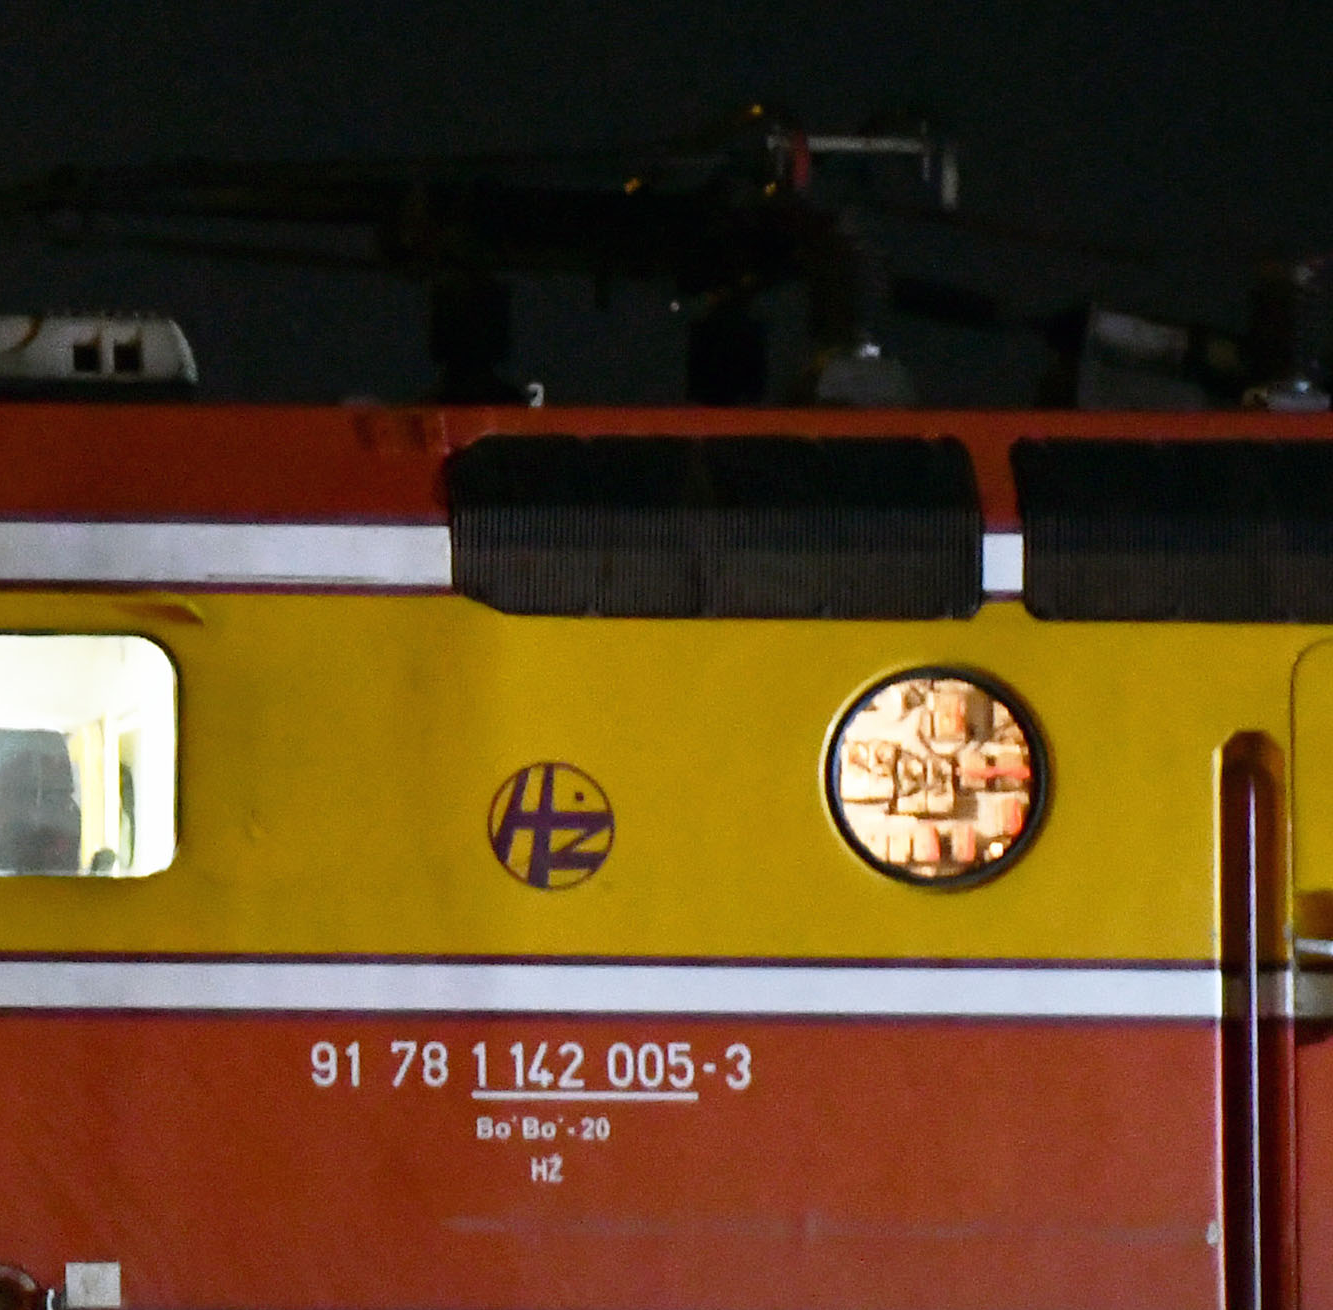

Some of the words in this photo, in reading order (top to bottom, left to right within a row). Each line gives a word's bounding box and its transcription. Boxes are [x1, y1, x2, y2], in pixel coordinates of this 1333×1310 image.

[311, 1041, 360, 1088] 91
[391, 1041, 449, 1088] 78
[510, 1042, 585, 1089] 142
